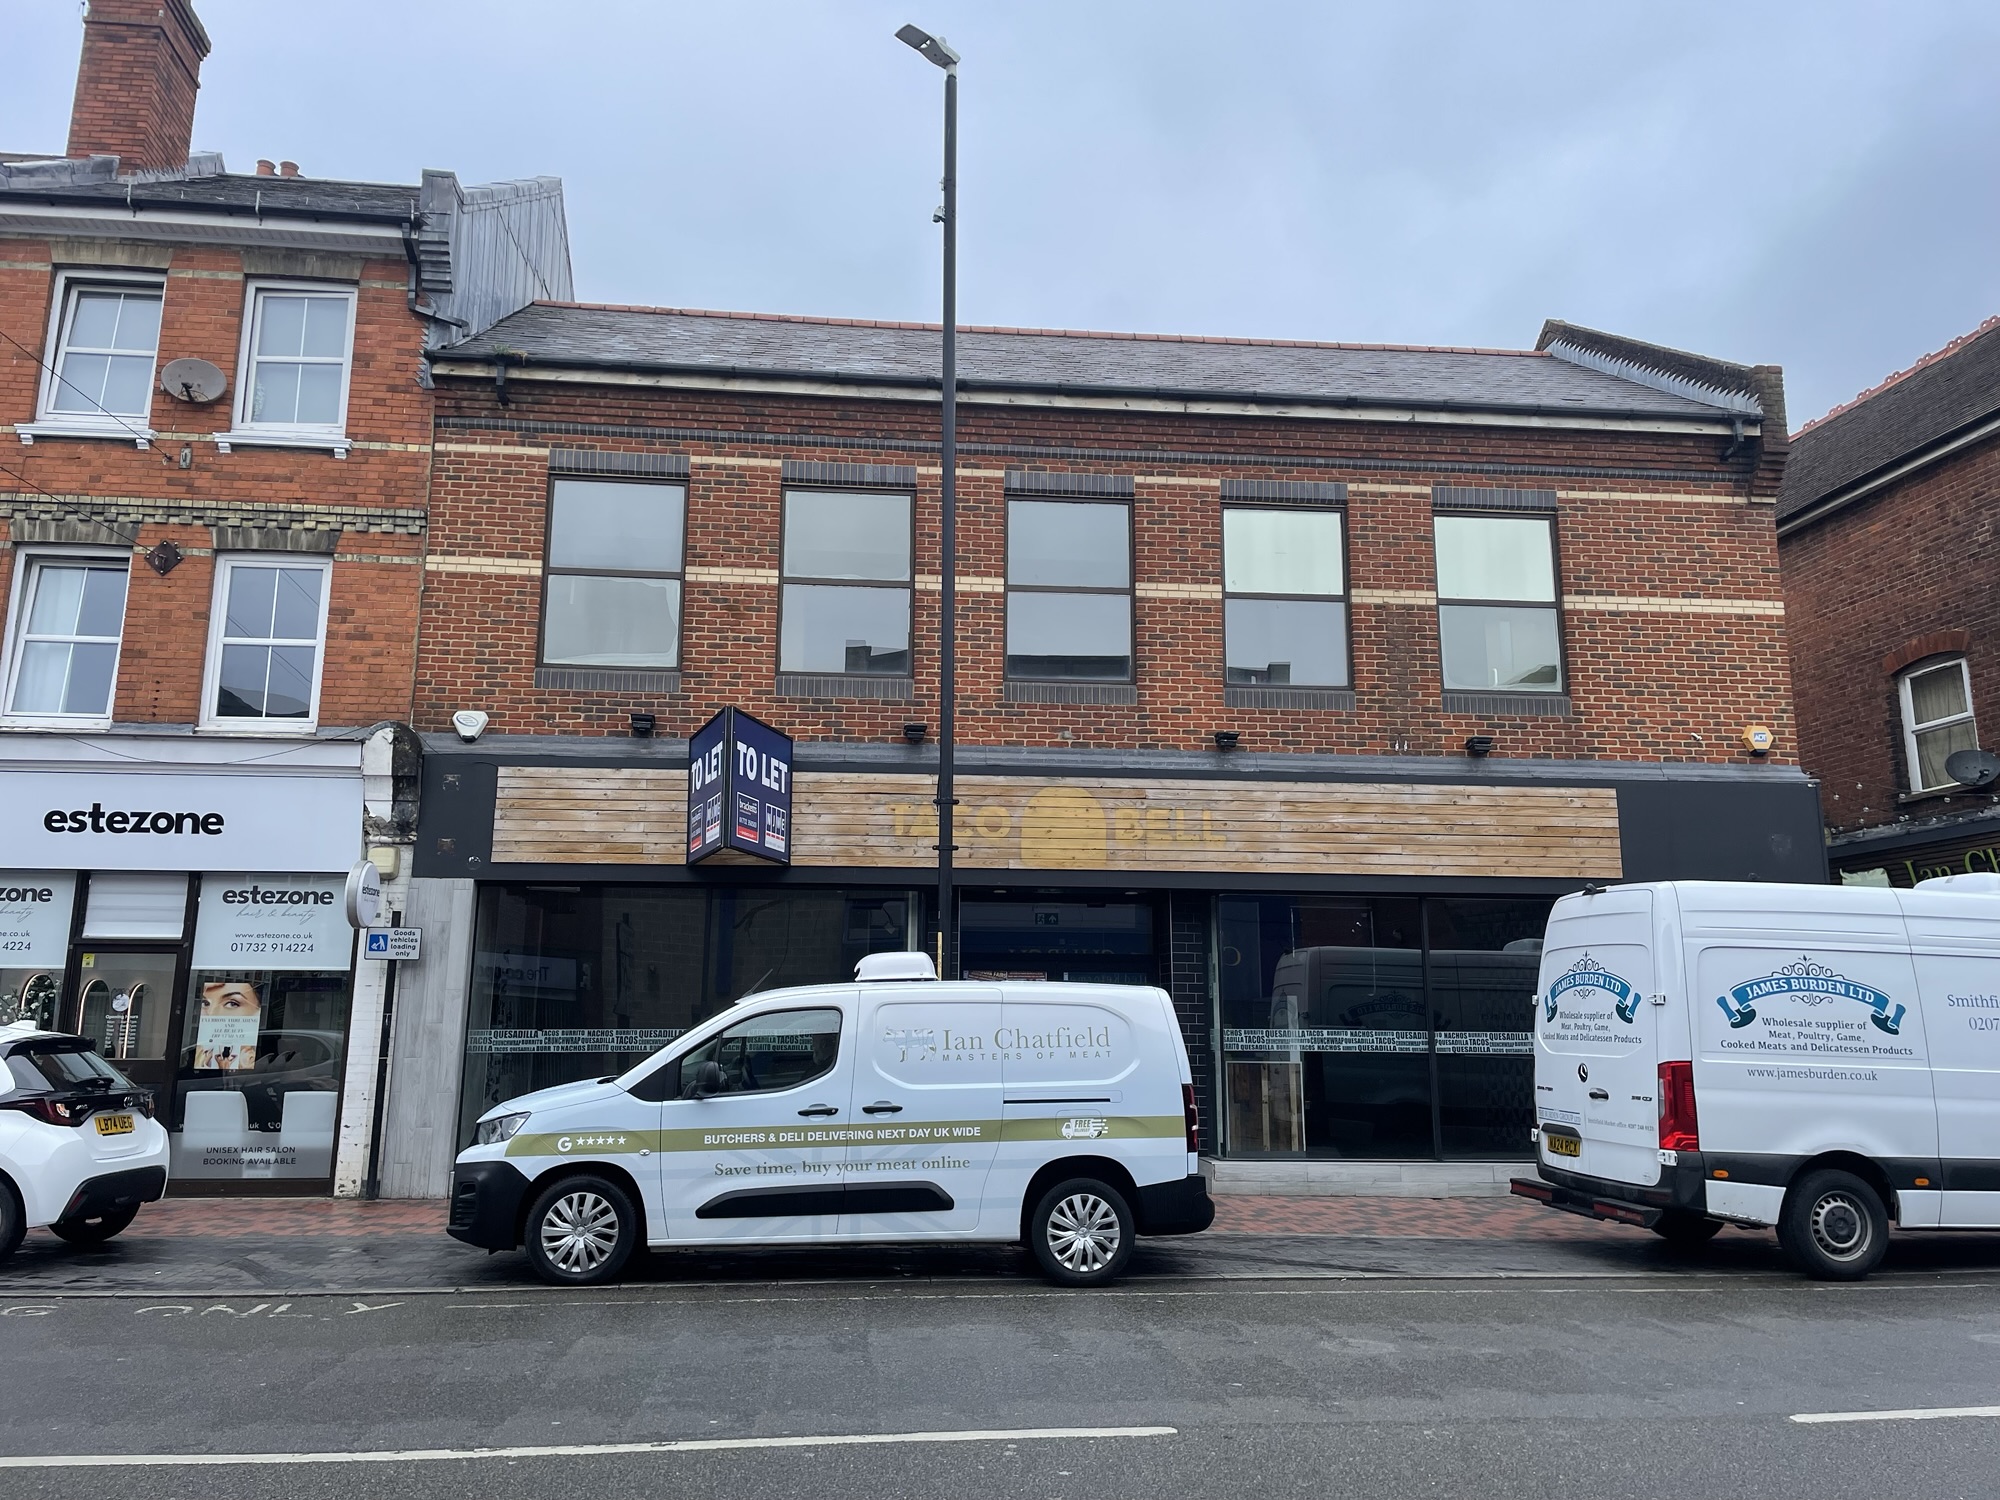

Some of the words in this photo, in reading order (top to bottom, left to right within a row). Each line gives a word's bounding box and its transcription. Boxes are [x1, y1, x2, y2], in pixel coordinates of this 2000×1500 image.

[1754, 733, 1767, 741] ADT
[691, 757, 703, 794] TO
[705, 740, 724, 785] LET
[736, 740, 758, 781] TO
[761, 753, 788, 794] LET
[43, 802, 225, 835] estezone
[1114, 806, 1227, 843] BELL
[222, 885, 334, 905] estezone
[236, 904, 265, 919] hair
[281, 905, 317, 925] beauty
[2, 941, 32, 951] 4224
[230, 942, 267, 952] 01732
[271, 943, 314, 953] 914224
[1554, 975, 1574, 996] JAMES
[1575, 973, 1604, 987] BURDEN
[1605, 977, 1621, 993] LTD
[1746, 978, 1788, 999] JAMES
[1790, 978, 1846, 995] BURDEN
[1849, 985, 1875, 1003] LTD
[1559, 1011, 1583, 1020] Wholesale
[1583, 1011, 1606, 1021] supplier
[1606, 1011, 1614, 1020] of
[1761, 1017, 1813, 1028] Wholesale
[1815, 1020, 1854, 1031] supplier
[1857, 1021, 1868, 1030] of
[1968, 1016, 2000, 1031] 0207
[469, 1036, 493, 1045] TACOS
[615, 1036, 639, 1045] TACOS
[493, 1030, 539, 1039] QUESADILLA
[747, 1036, 776, 1044] UESADILLA
[777, 1035, 799, 1044] TACOS
[942, 1029, 984, 1051] Ian
[994, 1026, 1111, 1050] Chatfield
[1244, 1035, 1265, 1044] TACOS
[1375, 1037, 1396, 1045] TACOS
[1264, 1029, 1306, 1038] QUESADILLA
[1395, 1031, 1428, 1040] QUESADIL
[1489, 1032, 1529, 1041] QUESADILLA
[1570, 1033, 1579, 1041] and
[1579, 1033, 1612, 1043] Delicatessen
[1613, 1034, 1642, 1044] Products
[1797, 1031, 1833, 1043] Poultry,
[1836, 1032, 1865, 1043] Game,
[587, 1044, 609, 1052] BURRITO
[772, 1044, 808, 1052] QUESADILLA
[1469, 1038, 1490, 1046] TACOS
[1720, 1039, 1756, 1049] Cooked
[1758, 1041, 1787, 1051] Meats
[1790, 1042, 1808, 1051] and
[1810, 1043, 1870, 1054] Delicatessen
[1872, 1045, 1913, 1056] Products
[942, 1052, 1023, 1062] MASTERS
[1036, 1051, 1055, 1060] OF
[1069, 1050, 1112, 1059] MEAT
[1747, 1067, 1878, 1081] www.jamesburden.co.uk
[99, 1117, 118, 1132] LB74
[119, 1116, 133, 1129] UEG
[1074, 1119, 1092, 1128] FREE
[704, 1133, 766, 1145] BUTCHERS
[768, 1133, 776, 1143] &
[779, 1131, 804, 1142] DELI
[807, 1129, 874, 1141] DELIVERING
[877, 1129, 906, 1139] NEXT
[909, 1128, 931, 1138] DAY
[934, 1127, 950, 1137] UK
[952, 1126, 981, 1137] WIDE
[206, 1146, 239, 1154] UNISEX
[241, 1146, 263, 1154] HAIR
[202, 1157, 245, 1165] BOOKING
[247, 1157, 297, 1165] AVAILABLE
[714, 1162, 751, 1176] Save
[755, 1161, 797, 1177] time,
[802, 1160, 831, 1177] buy
[836, 1162, 873, 1177] your
[876, 1158, 917, 1171] meat
[921, 1155, 971, 1170] online
